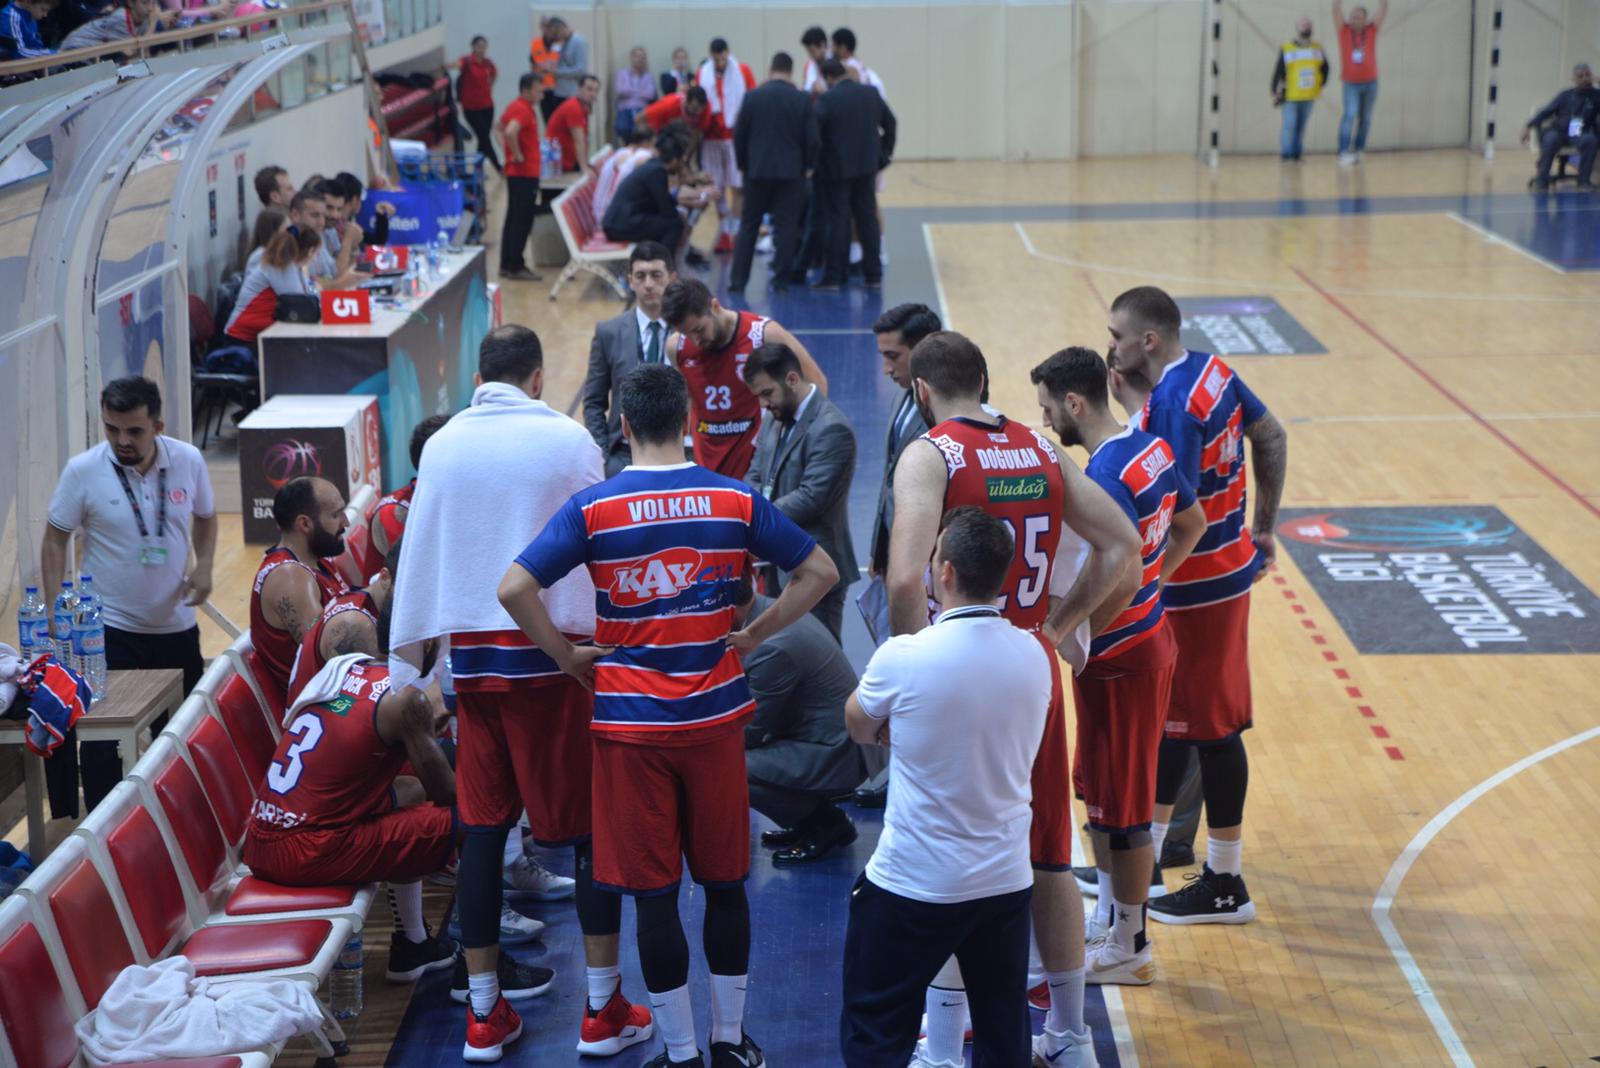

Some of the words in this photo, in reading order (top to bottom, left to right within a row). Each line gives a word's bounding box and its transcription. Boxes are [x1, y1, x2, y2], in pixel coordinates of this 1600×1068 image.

[332, 298, 359, 317] 5
[704, 385, 732, 411] 23
[976, 445, 1042, 470] DOĞUKAN
[988, 479, 1048, 499] uludağ
[627, 495, 712, 522] VOLKAN
[998, 515, 1050, 608] 5
[616, 559, 694, 599] KAY
[1463, 552, 1586, 618] TÜRKİYE
[1388, 552, 1529, 648] BASKETBOL
[266, 712, 324, 795] 3
